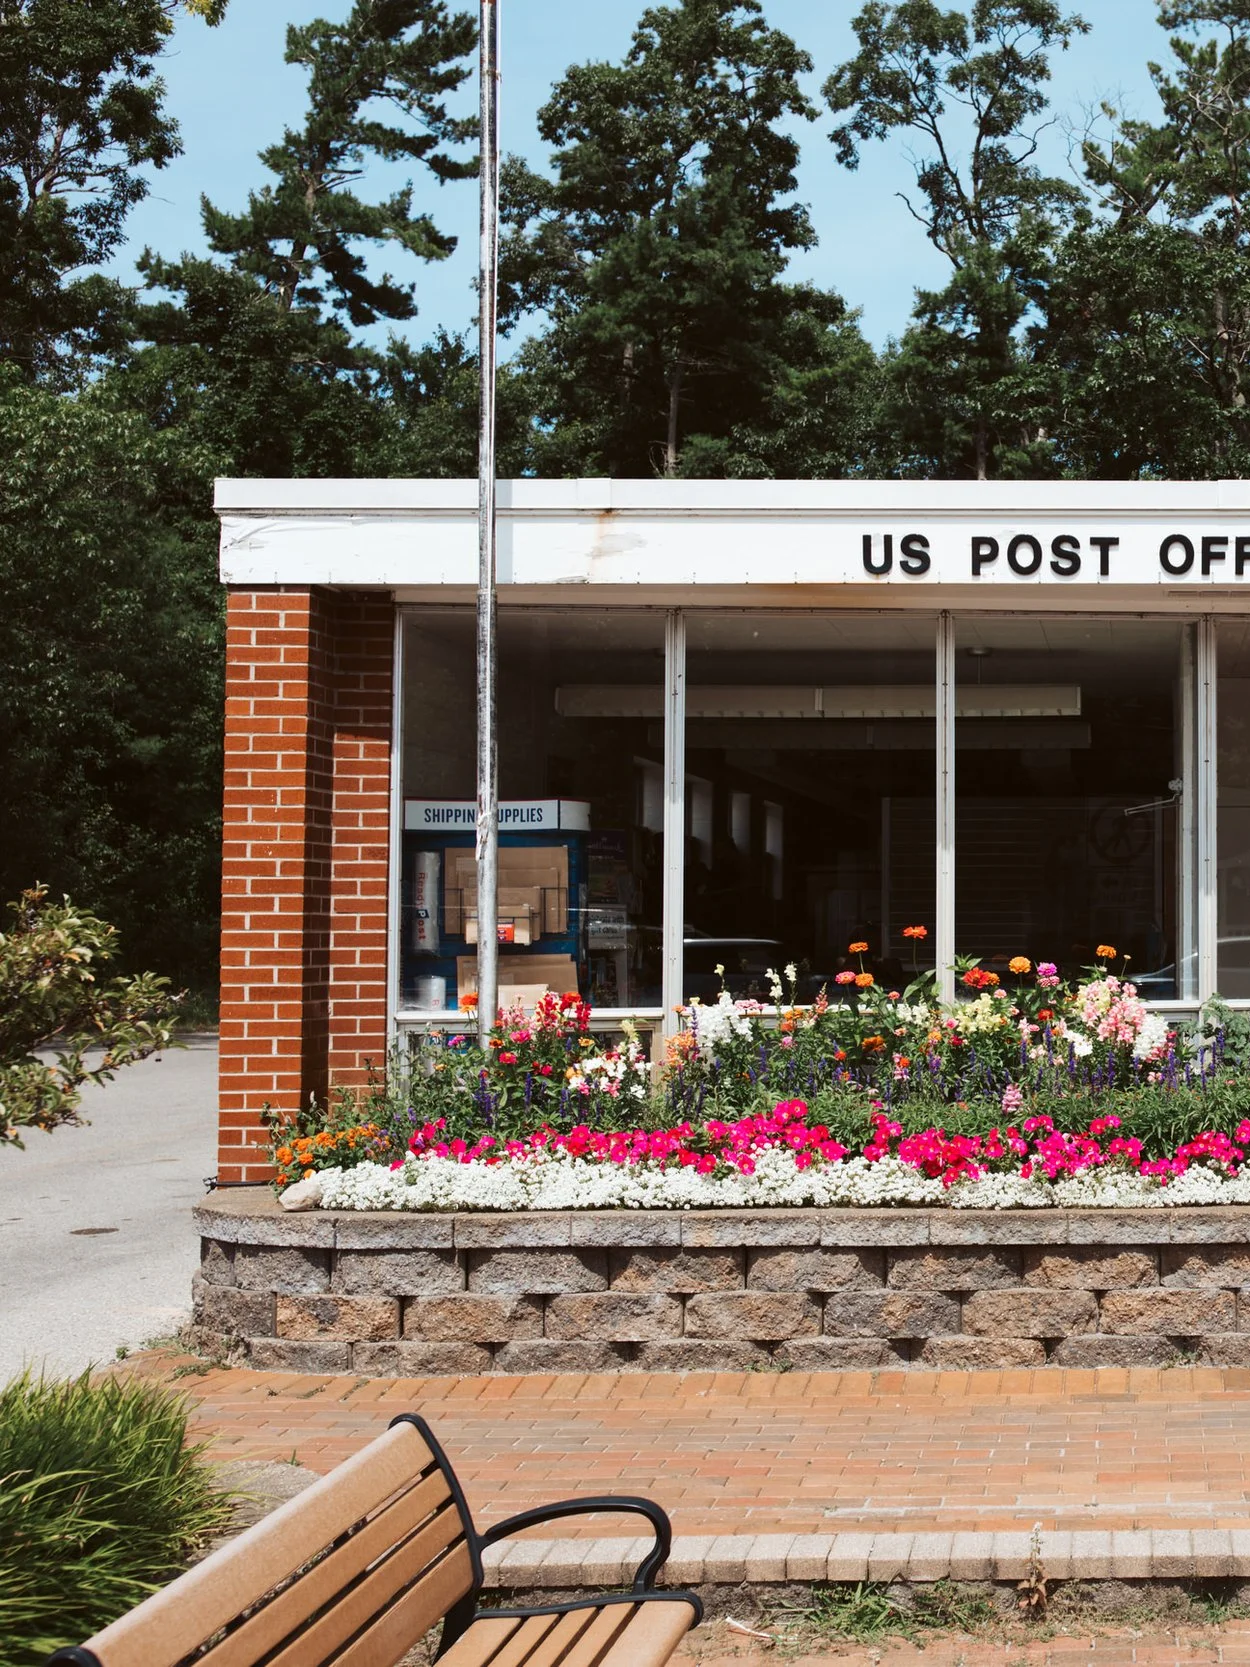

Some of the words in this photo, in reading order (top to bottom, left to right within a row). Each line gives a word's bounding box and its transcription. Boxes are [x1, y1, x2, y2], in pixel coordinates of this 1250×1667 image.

[862, 534, 931, 576] US
[971, 534, 1119, 576] POST
[424, 808, 476, 823] SHIPPIN
[497, 808, 543, 823] UPPLIES
